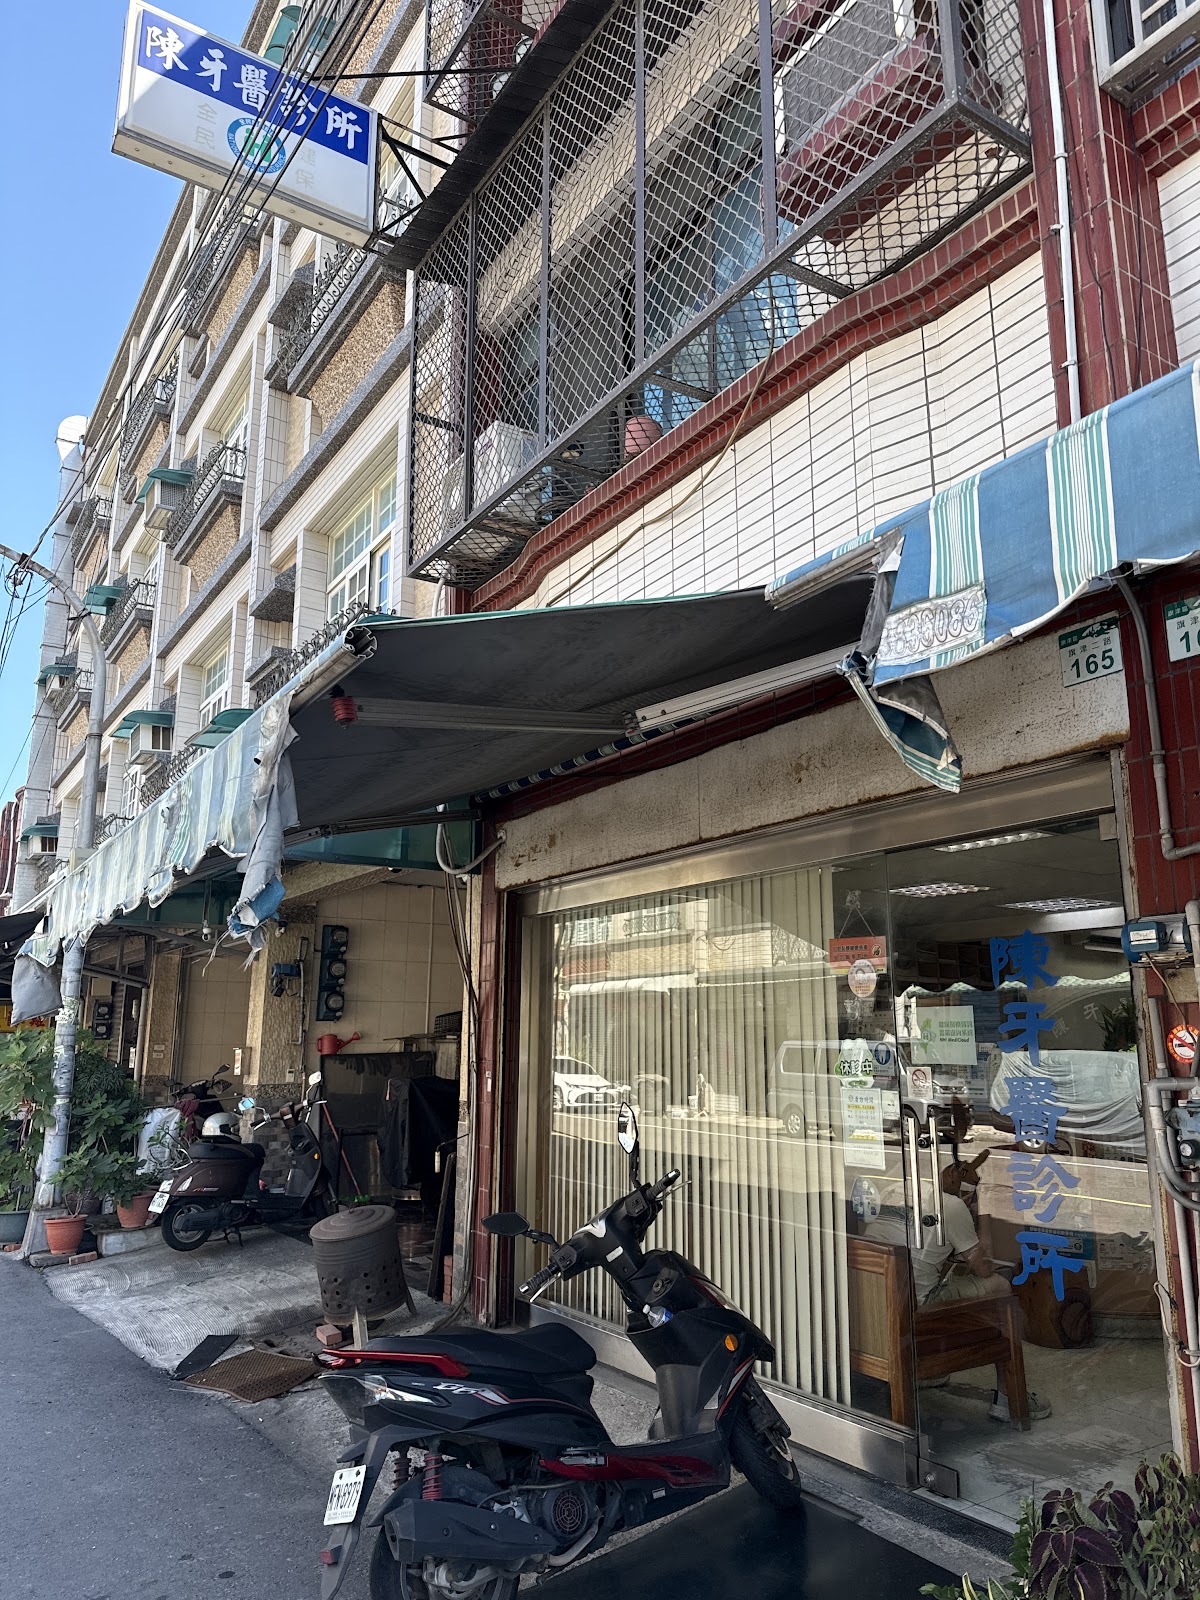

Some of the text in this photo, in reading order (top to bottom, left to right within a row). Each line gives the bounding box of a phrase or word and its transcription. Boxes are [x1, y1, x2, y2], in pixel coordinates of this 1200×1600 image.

[145, 25, 363, 150] 陳牙醫診所
[194, 102, 218, 150] 全民
[1068, 636, 1112, 657] 旗津二路
[1179, 631, 1200, 653] 1
[1071, 648, 1115, 679] 165
[990, 929, 1084, 1302] 陳牙醫診所
